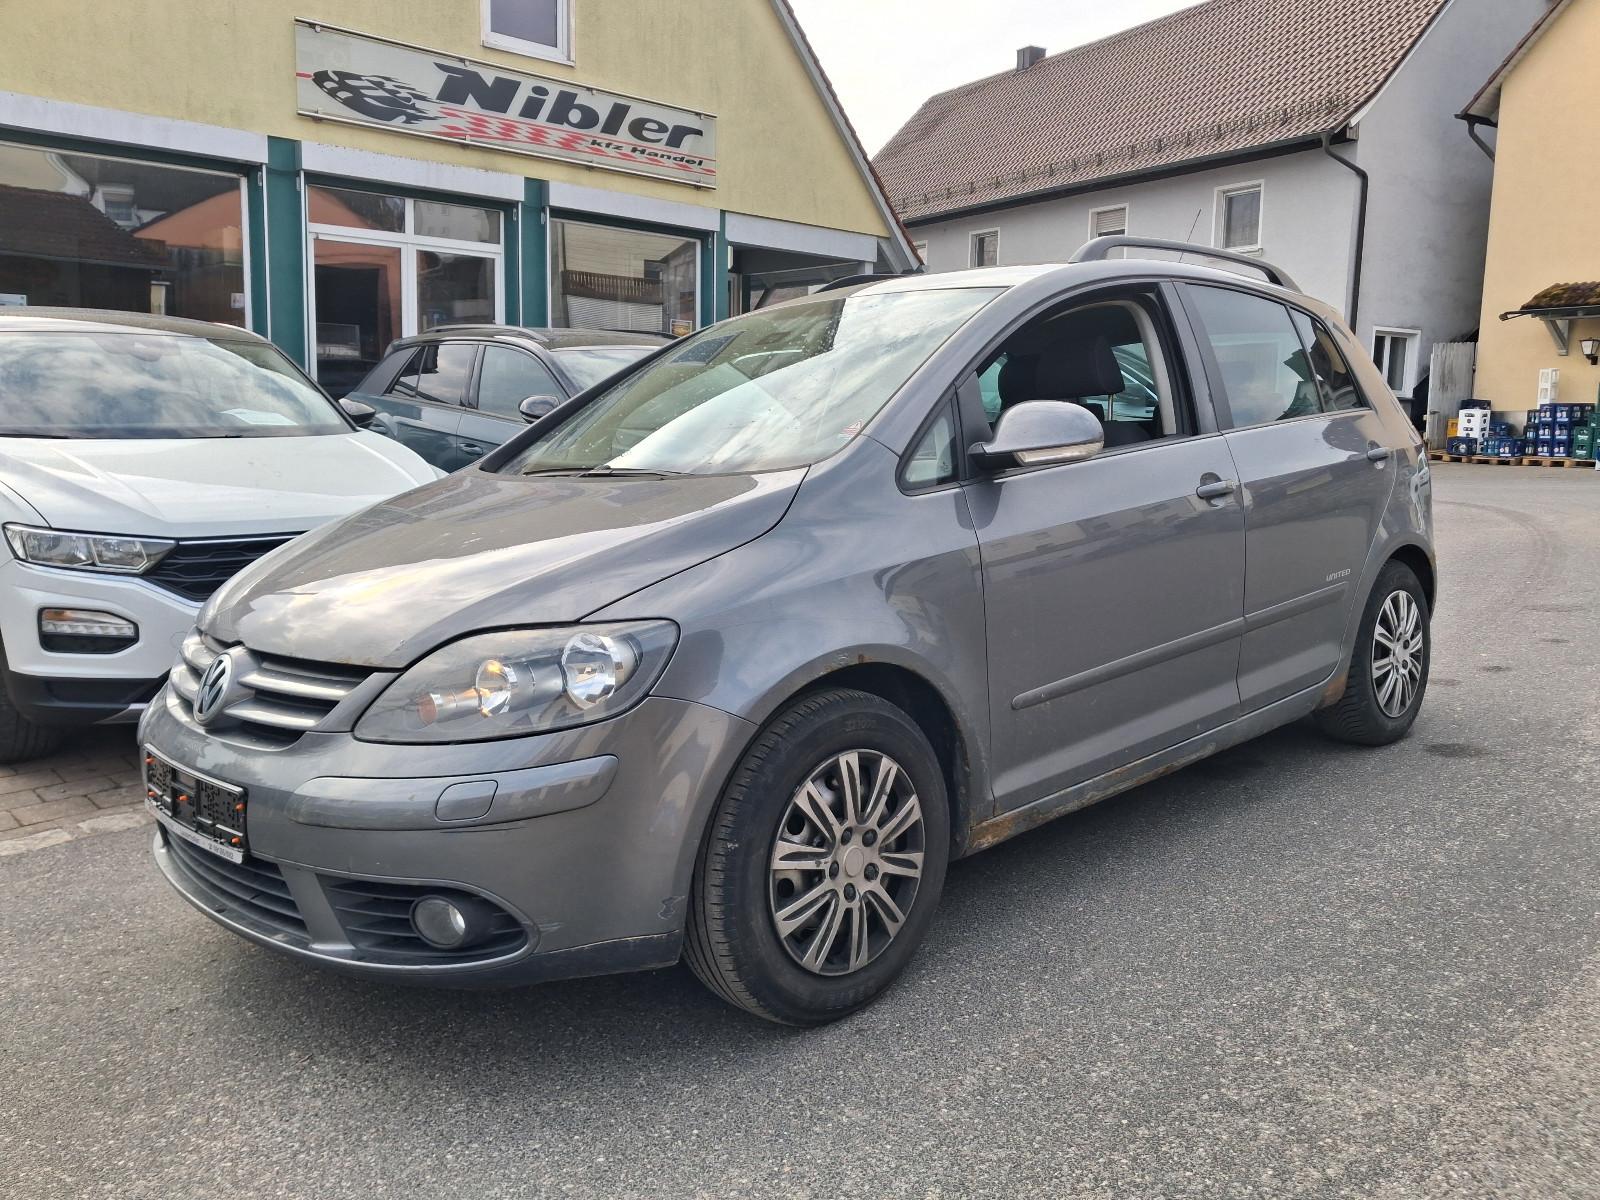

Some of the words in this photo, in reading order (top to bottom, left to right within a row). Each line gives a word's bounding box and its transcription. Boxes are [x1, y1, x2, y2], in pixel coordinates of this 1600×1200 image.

[434, 62, 704, 148] Nibler
[631, 147, 704, 166] Handel
[1326, 568, 1351, 582] UNITED
